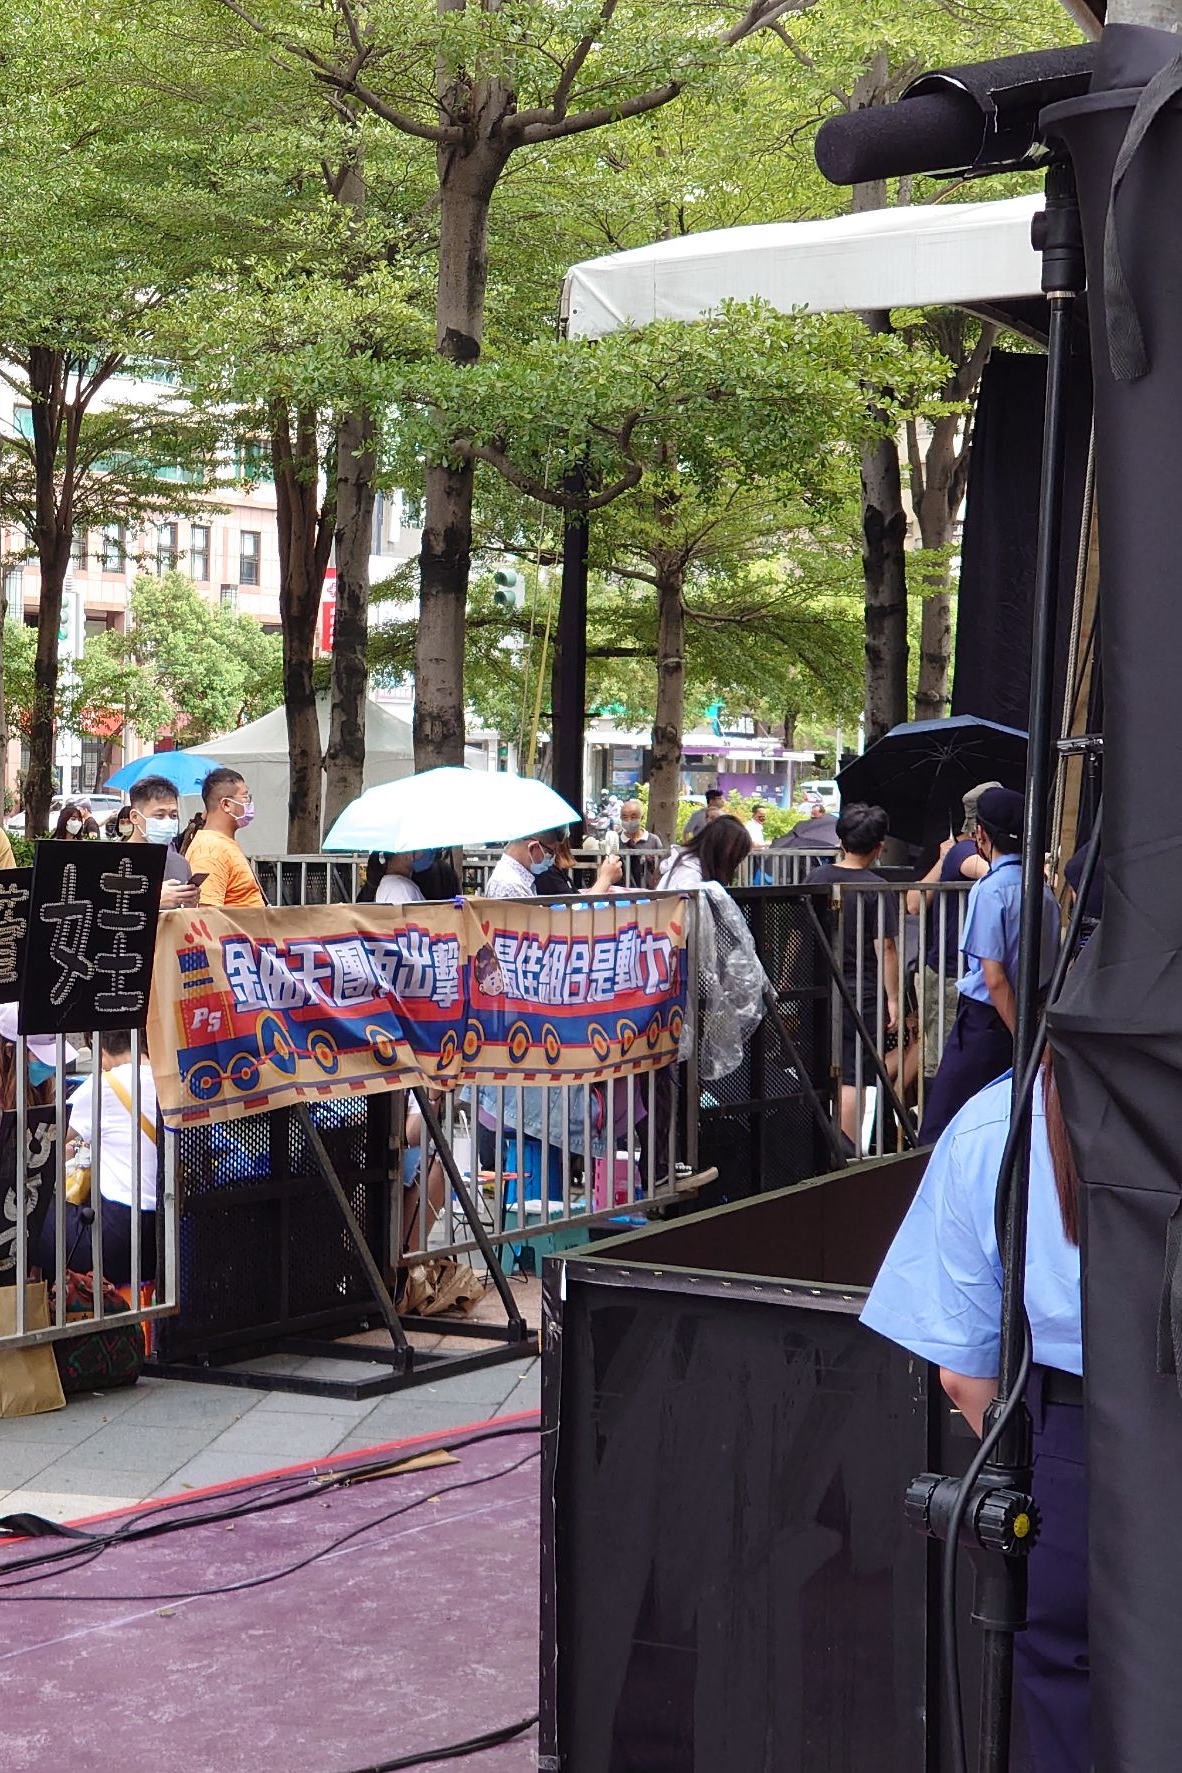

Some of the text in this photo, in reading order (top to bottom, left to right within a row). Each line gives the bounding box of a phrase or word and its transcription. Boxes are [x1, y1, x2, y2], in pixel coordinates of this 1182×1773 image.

[494, 929, 672, 1004] 最佳組合是動力
[191, 1007, 222, 1033] PS
